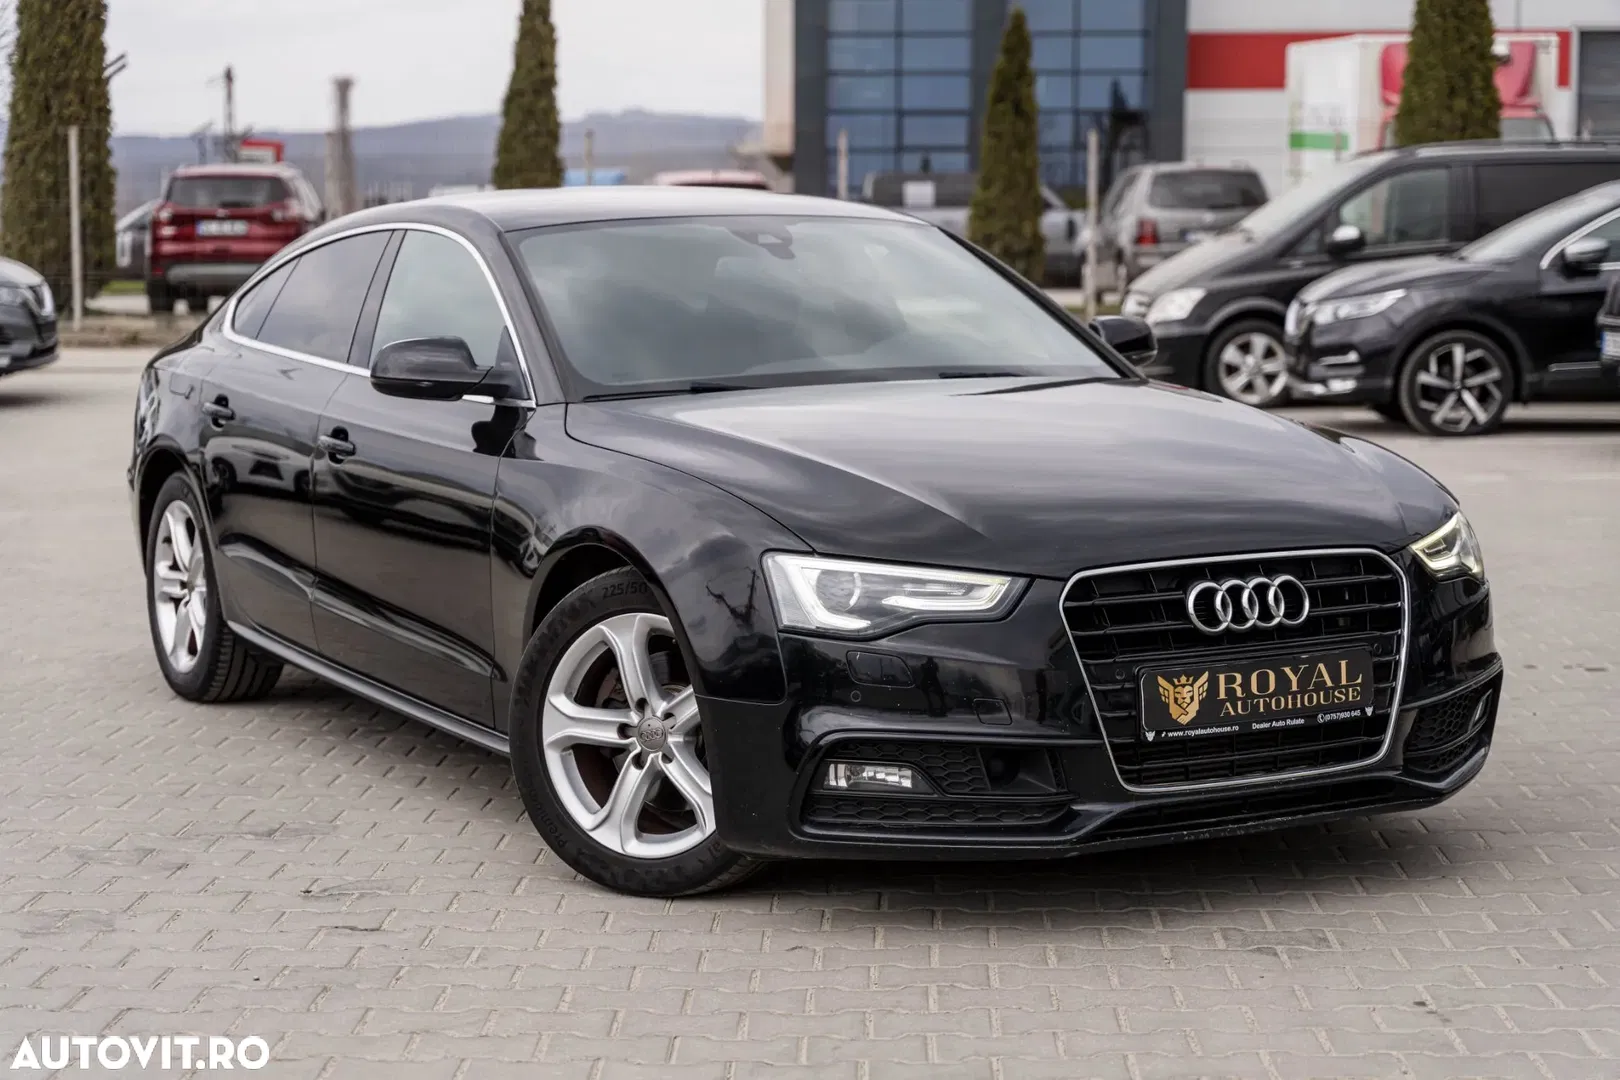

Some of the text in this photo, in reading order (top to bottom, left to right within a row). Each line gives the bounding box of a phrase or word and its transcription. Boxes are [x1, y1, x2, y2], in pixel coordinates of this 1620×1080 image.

[602, 581, 648, 600] 225/50
[1216, 660, 1363, 700] ROYAL
[1219, 686, 1361, 717] AUTOHOUSE
[1167, 725, 1239, 738] www.royalautohouse.ro
[1252, 718, 1305, 730] Dealer Auto Rulate
